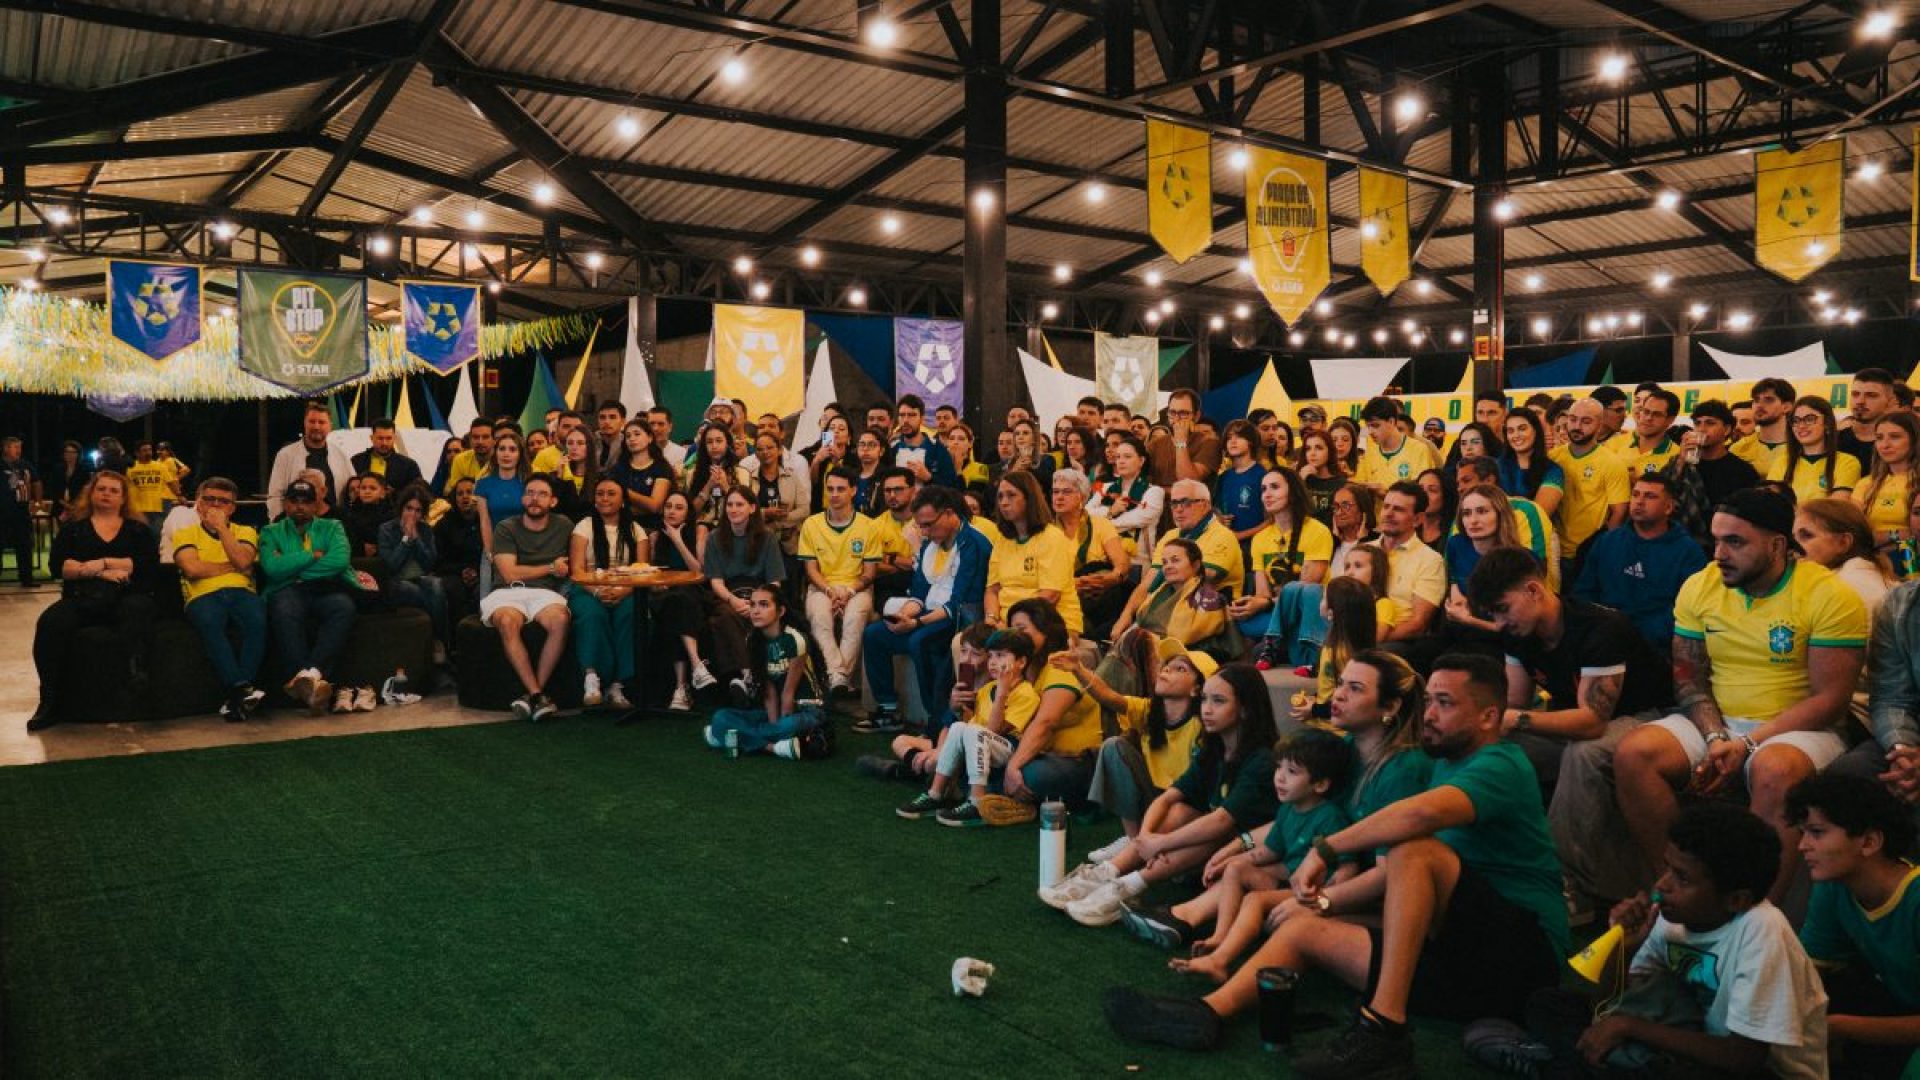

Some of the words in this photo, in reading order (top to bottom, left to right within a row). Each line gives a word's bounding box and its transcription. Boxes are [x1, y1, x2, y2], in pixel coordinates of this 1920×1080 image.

[292, 287, 316, 309] PIT
[286, 308, 324, 332] STOP
[296, 364, 329, 374] STAR
[132, 475, 161, 486] STAR
